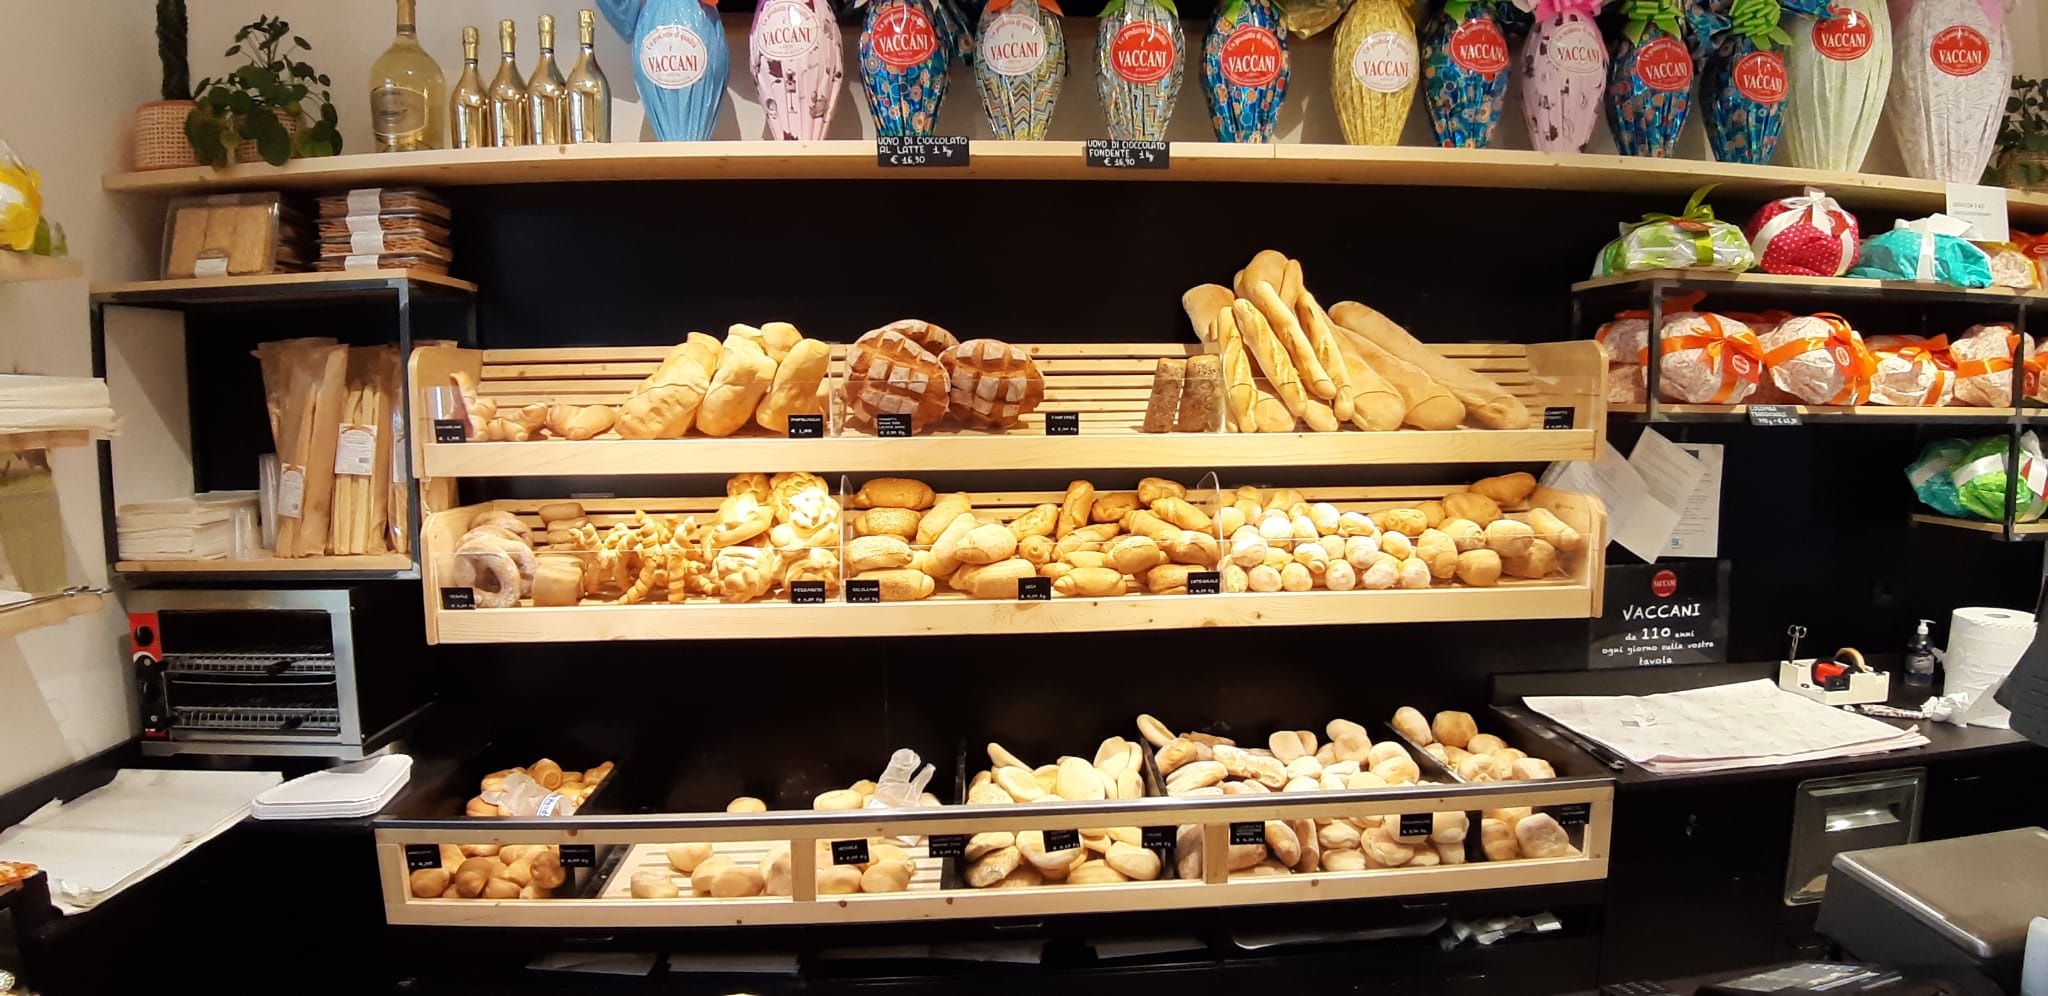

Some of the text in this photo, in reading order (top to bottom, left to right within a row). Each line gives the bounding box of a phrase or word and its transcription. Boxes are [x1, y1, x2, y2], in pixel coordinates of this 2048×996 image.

[762, 26, 811, 47] VACCANI
[879, 33, 929, 53] VACCANI
[1821, 32, 1867, 48] VACCANI
[990, 42, 1039, 60] VACCANI
[1118, 49, 1167, 69] VACCANI
[1557, 46, 1600, 64] VACCANI
[1939, 49, 1983, 64] VACCANI
[648, 55, 698, 73] VACCANI
[1228, 54, 1276, 73] VACCANI
[1363, 60, 1409, 78] VACCANI
[1645, 62, 1688, 80] VACCANI
[1743, 74, 1783, 93] VACCANI
[878, 136, 968, 146] UOVO DI CIOCCOLATO
[879, 146, 891, 154] AL
[897, 145, 925, 154] LATTE
[932, 145, 940, 154] 1
[1088, 140, 1166, 150] UOVO DI CIOCCOLATO
[890, 155, 899, 164] €
[1089, 149, 1130, 158] FONDENTE
[1104, 157, 1112, 166] €
[1622, 603, 1701, 621] VACCANI
[1625, 627, 1695, 641] da 110 anni
[1601, 640, 1715, 656] ogni giorno sulla vostra
[1638, 655, 1673, 666] tavola
